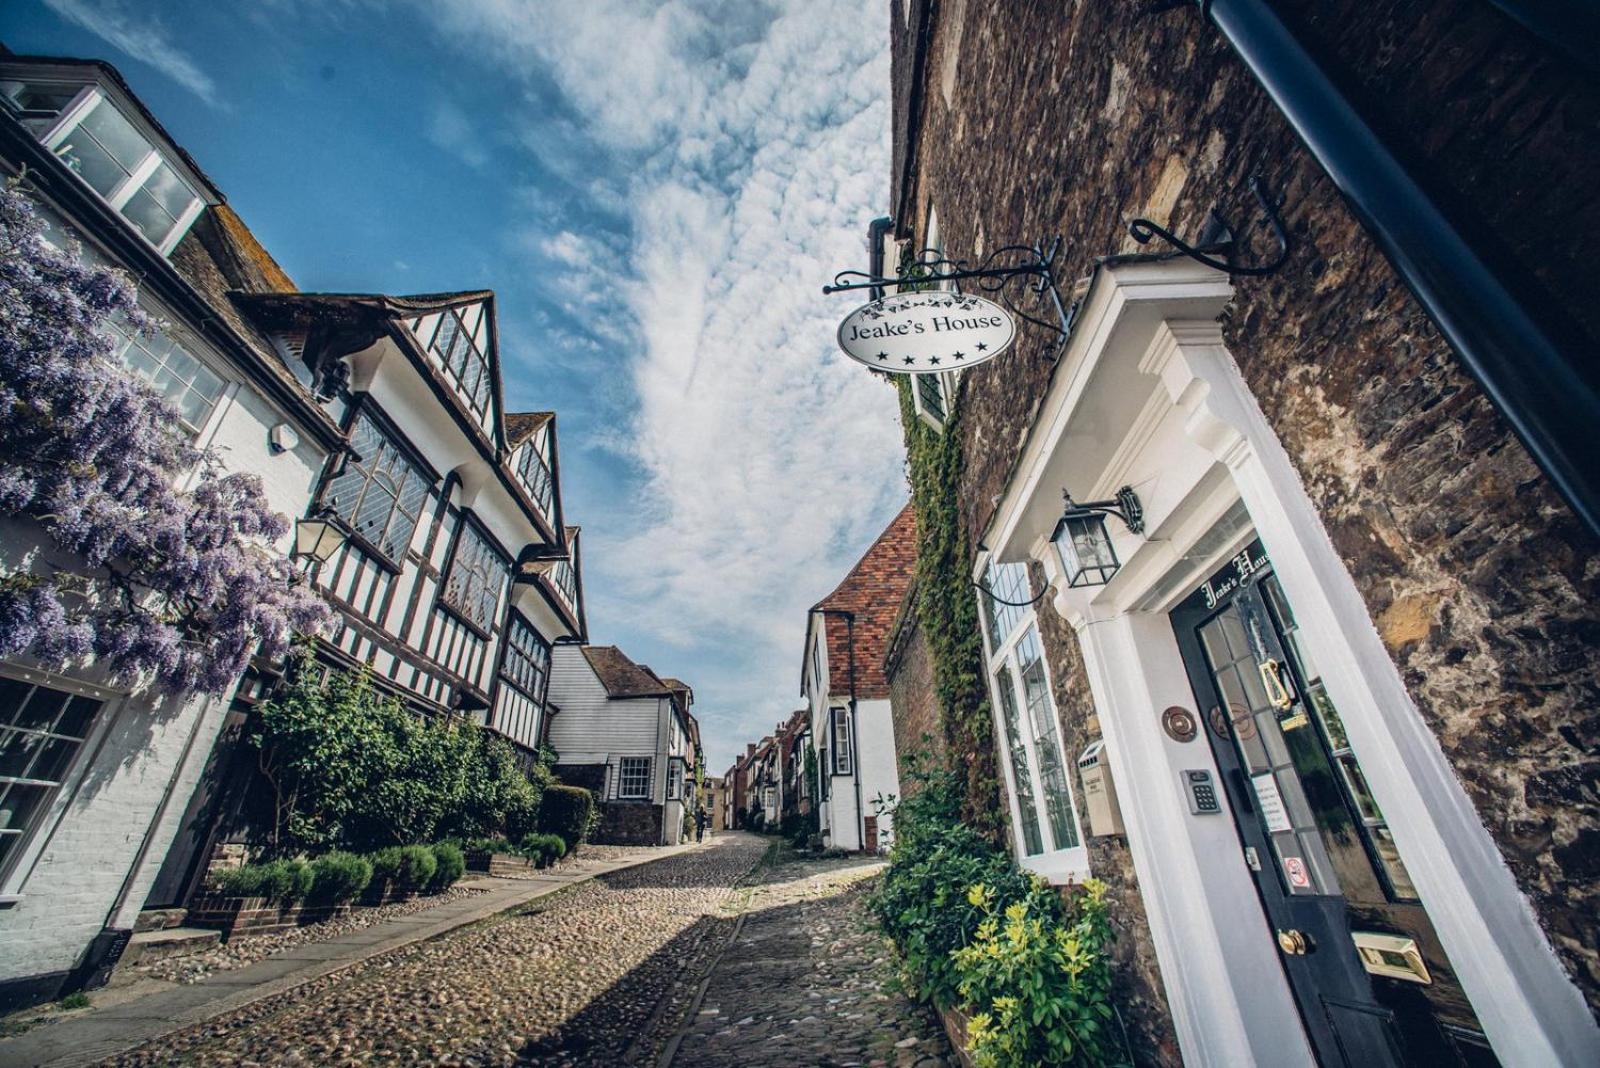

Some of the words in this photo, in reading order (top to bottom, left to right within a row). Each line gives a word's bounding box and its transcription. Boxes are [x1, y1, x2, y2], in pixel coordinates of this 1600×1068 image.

[850, 319, 925, 341] Jeake's
[932, 315, 1002, 332] House
[1232, 549, 1270, 588] Hous
